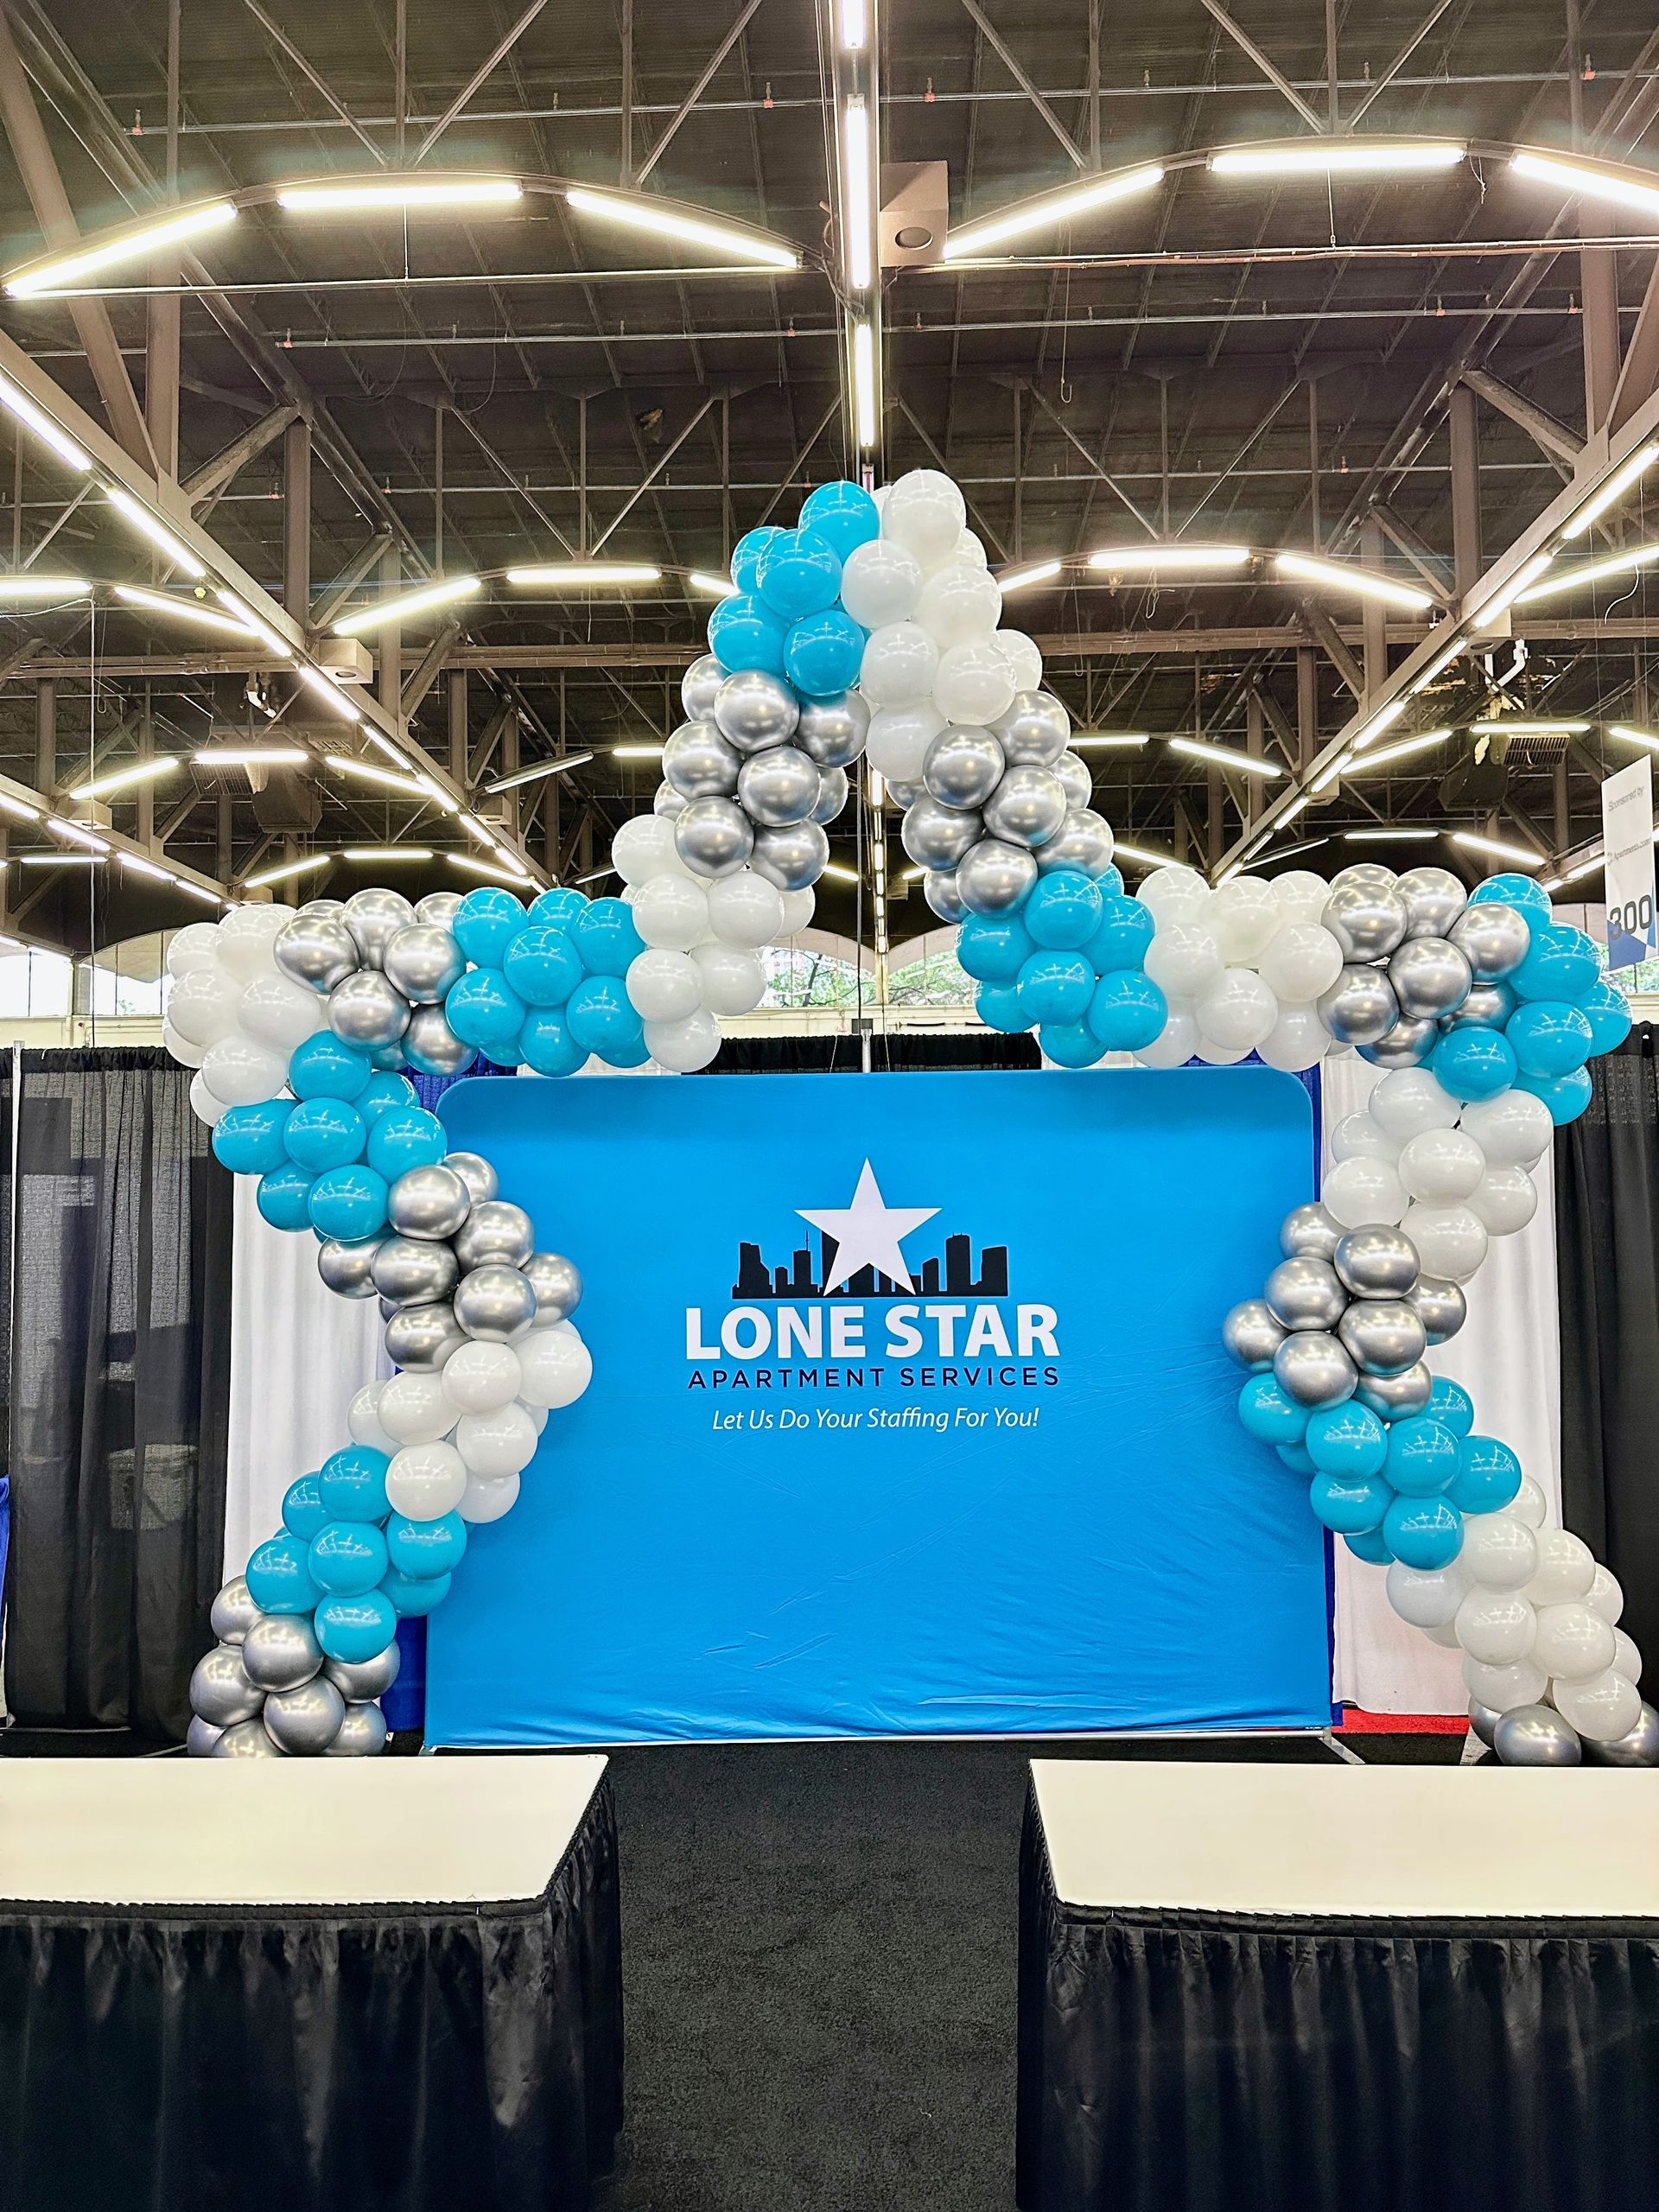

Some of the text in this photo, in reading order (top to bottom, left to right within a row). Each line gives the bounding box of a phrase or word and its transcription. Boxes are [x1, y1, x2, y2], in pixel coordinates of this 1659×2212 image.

[1608, 787, 1637, 811] Sponsored
[1609, 894, 1653, 940] 300
[685, 1303, 1061, 1360] LONE STAR
[688, 1366, 1059, 1389] APARTMENT SERVICES
[713, 1407, 1039, 1433] Let Us Do Your Staffing For You!
